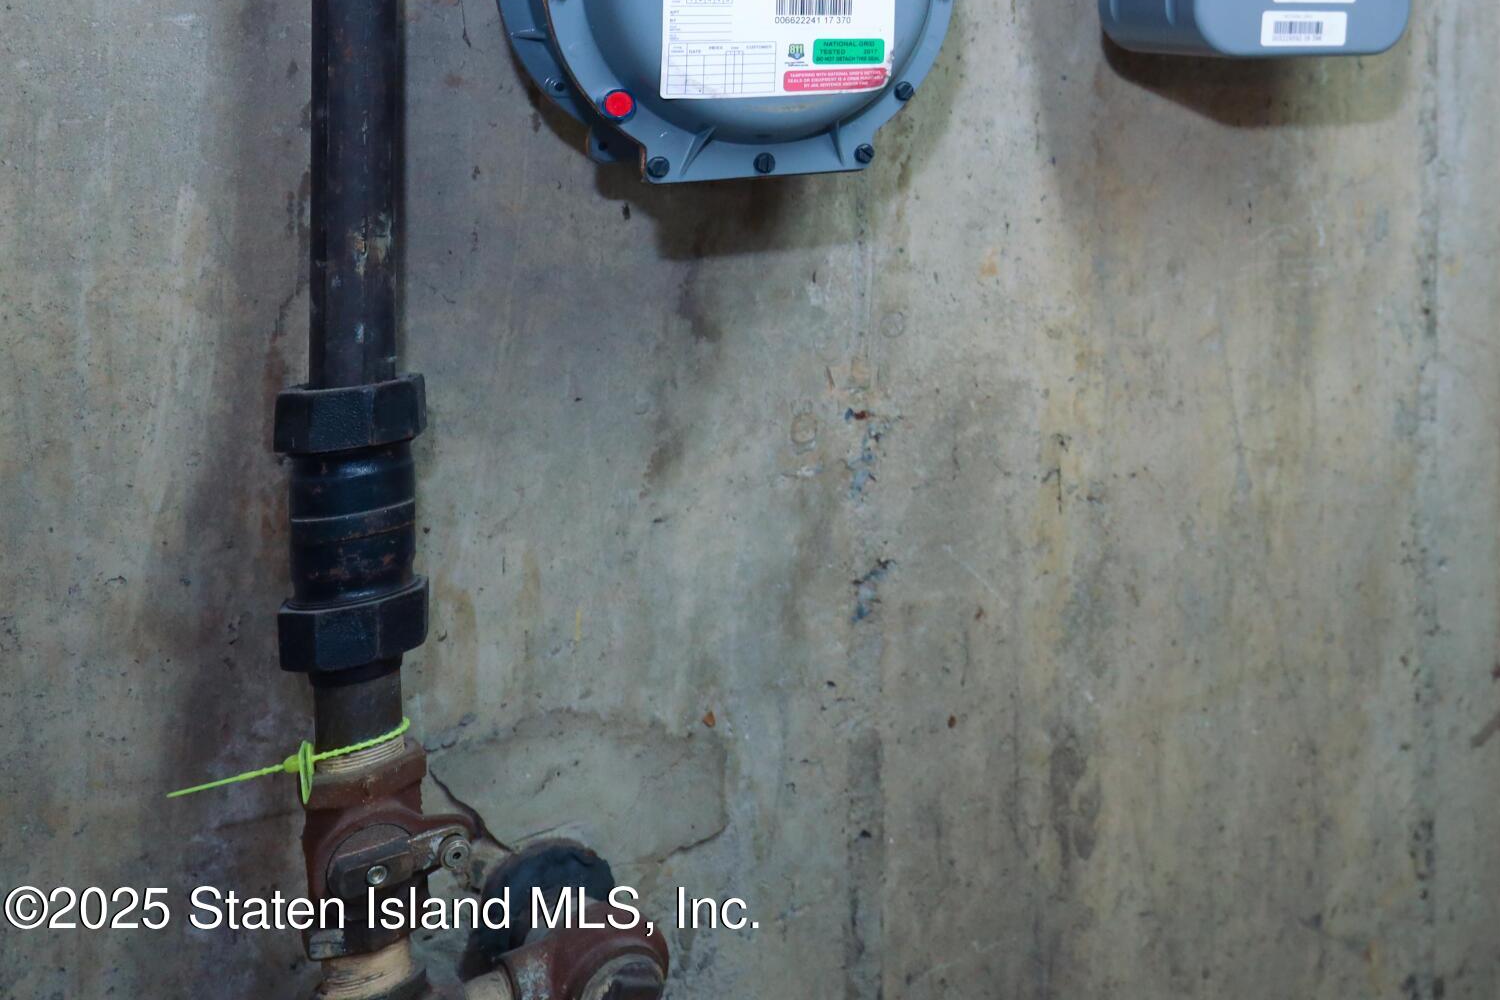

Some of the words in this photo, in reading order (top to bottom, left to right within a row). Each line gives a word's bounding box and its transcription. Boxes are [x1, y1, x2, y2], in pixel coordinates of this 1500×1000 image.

[774, 16, 821, 25] 006622241
[824, 16, 834, 25] 17
[836, 16, 852, 25] 370
[823, 40, 857, 48] NATIONAL
[789, 44, 803, 55] 811
